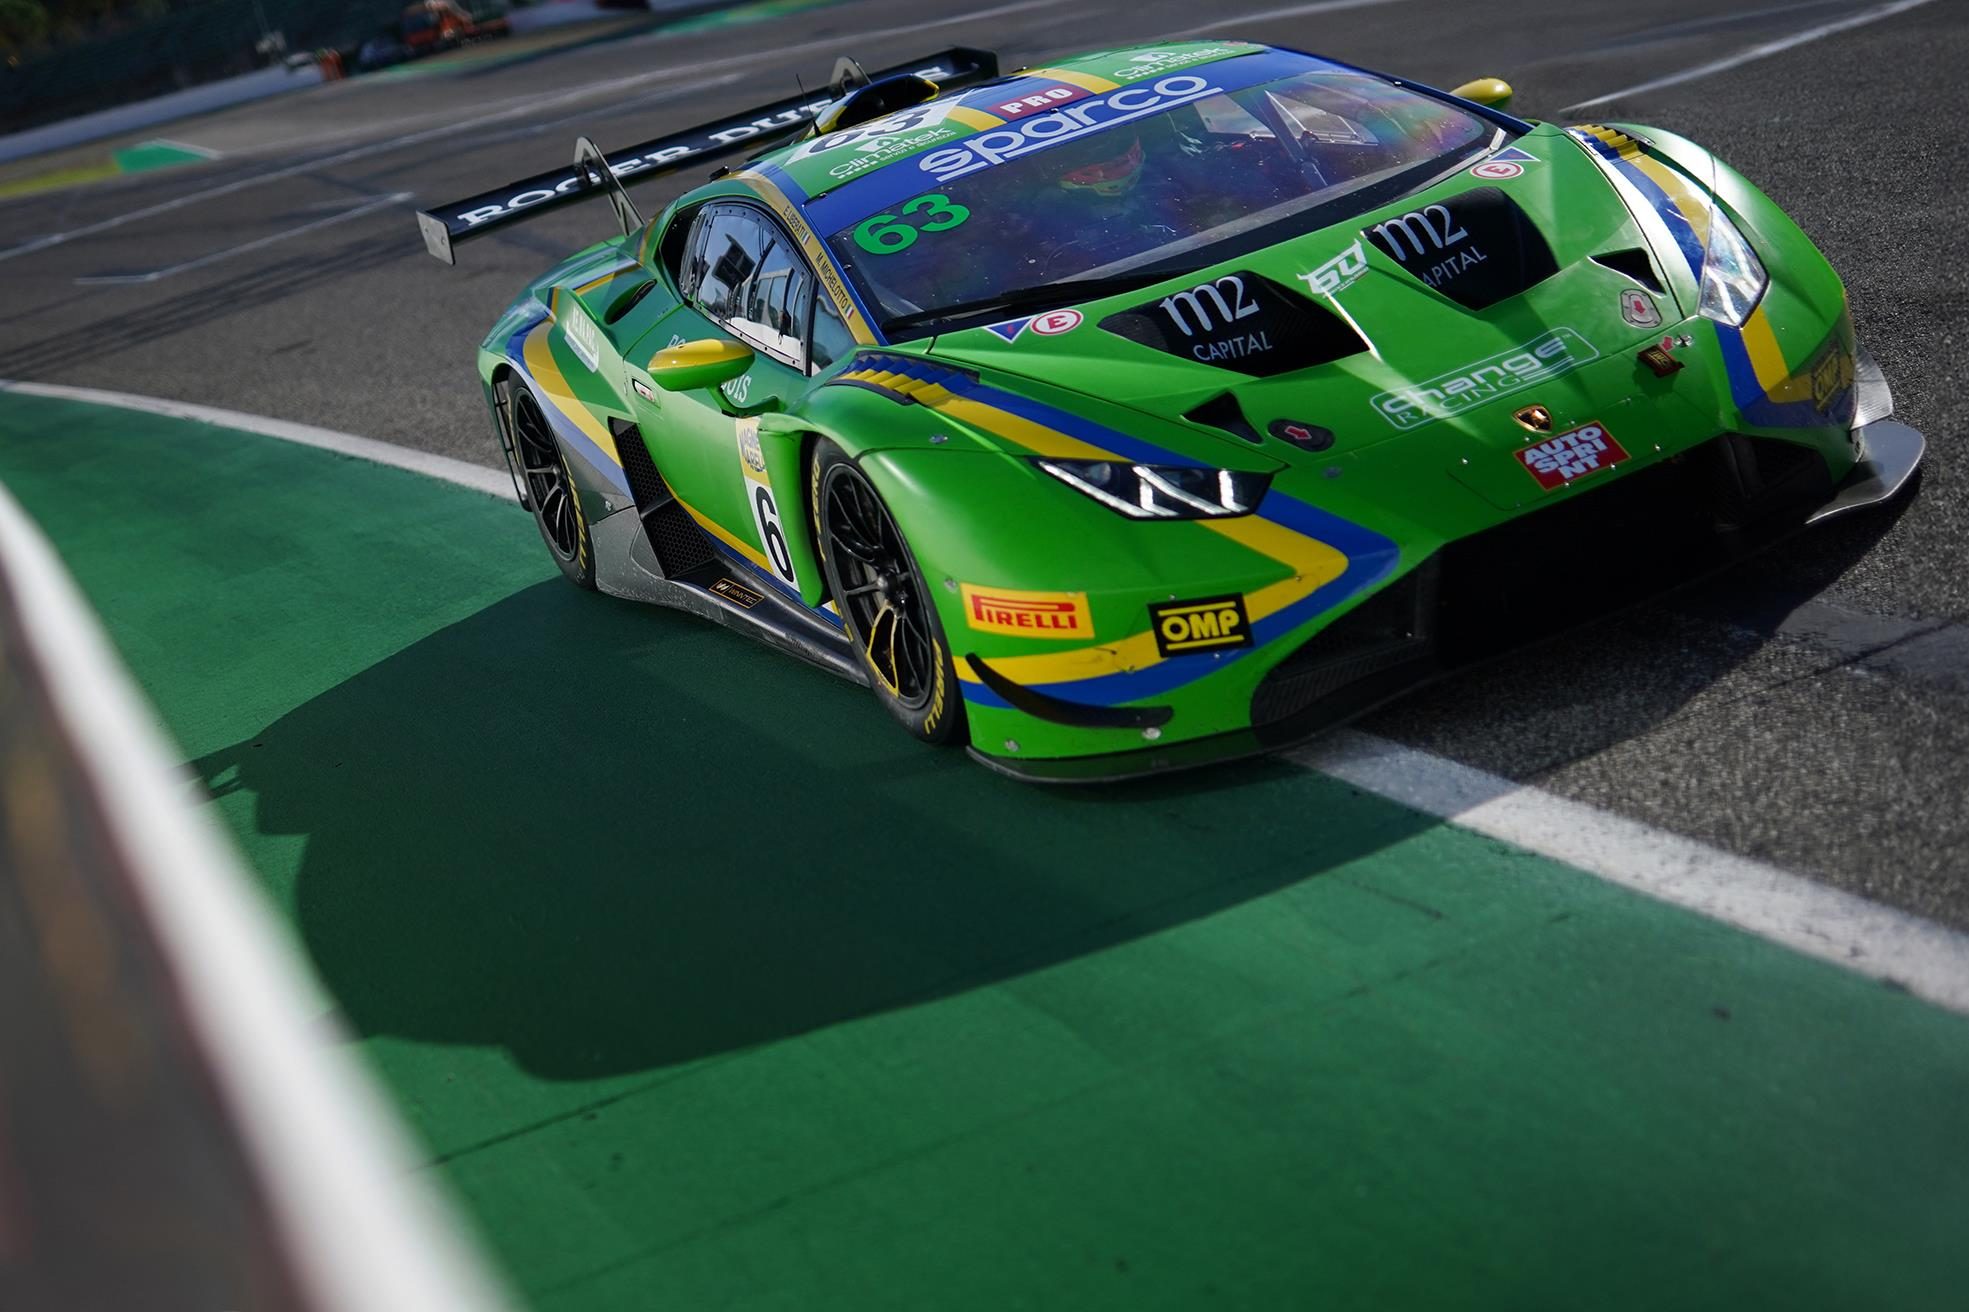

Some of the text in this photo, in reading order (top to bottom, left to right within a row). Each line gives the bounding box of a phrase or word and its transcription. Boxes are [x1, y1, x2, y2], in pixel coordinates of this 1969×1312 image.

[1000, 88, 1073, 115] PRO
[919, 76, 1208, 175] sparco
[829, 127, 951, 176] Climatek
[1483, 165, 1511, 175] E
[853, 194, 971, 255] 63
[820, 260, 849, 309] MICHELOTTO
[1422, 246, 1488, 288] APITAL
[1046, 315, 1067, 330] E
[1193, 332, 1272, 361] CAPITAL
[1523, 426, 1603, 466] AUTO
[1534, 438, 1608, 474] SPRI
[1558, 455, 1600, 480] NT
[755, 486, 794, 584] 6
[970, 594, 1078, 630] PIRELLI
[1161, 608, 1241, 642] OMP
